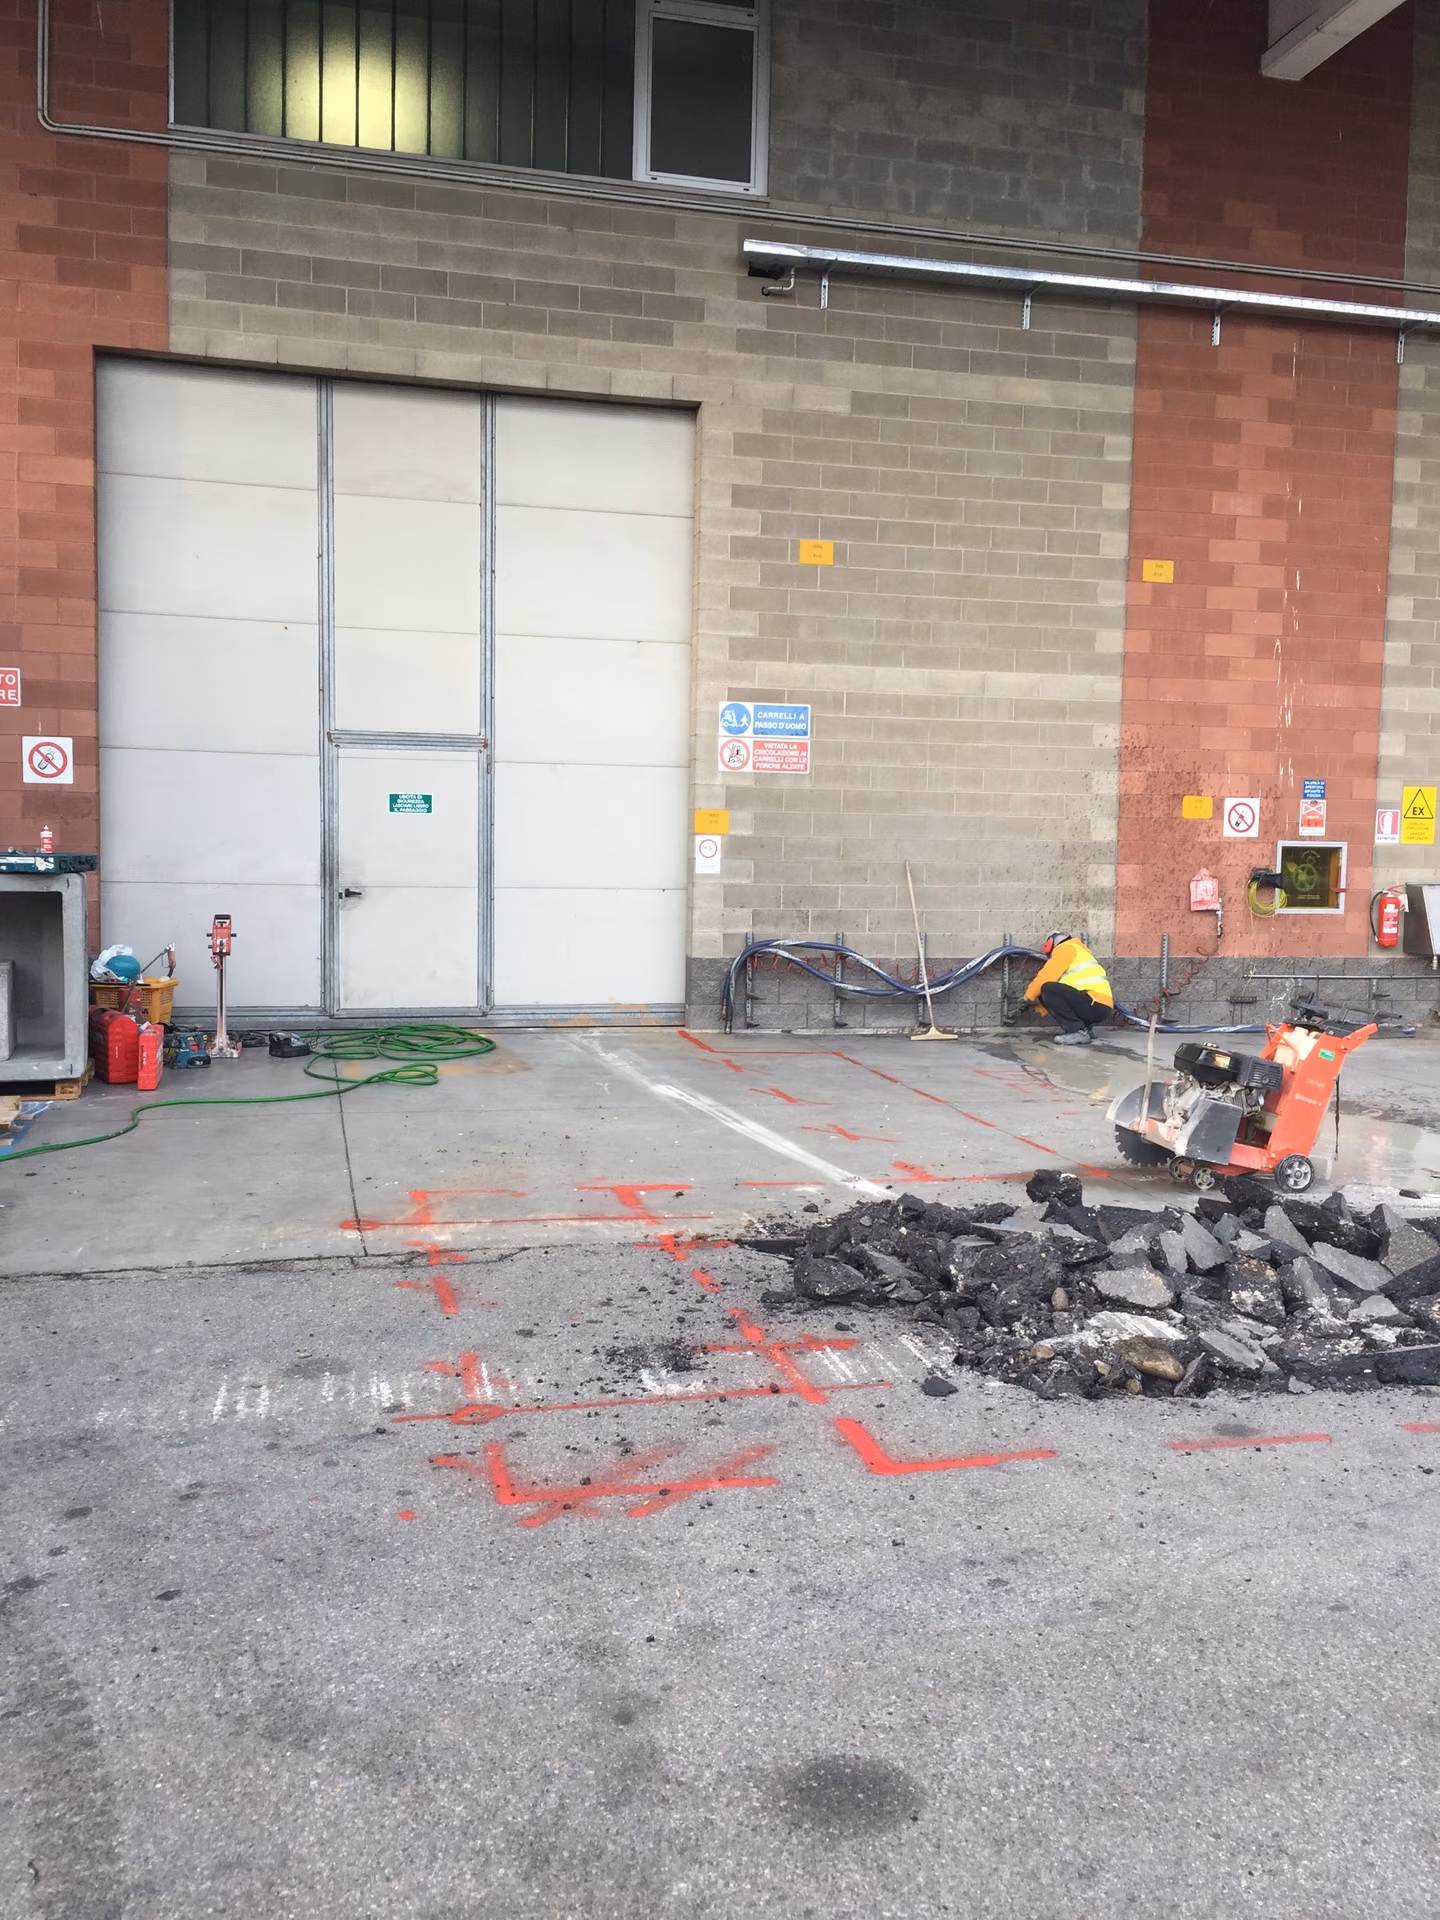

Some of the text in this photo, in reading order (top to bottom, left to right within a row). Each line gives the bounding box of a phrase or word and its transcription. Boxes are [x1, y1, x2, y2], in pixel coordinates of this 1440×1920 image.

[757, 711, 805, 720] CARRELLI A
[754, 721, 807, 730] PASSO D'UOMO
[1412, 806, 1425, 816] EX
